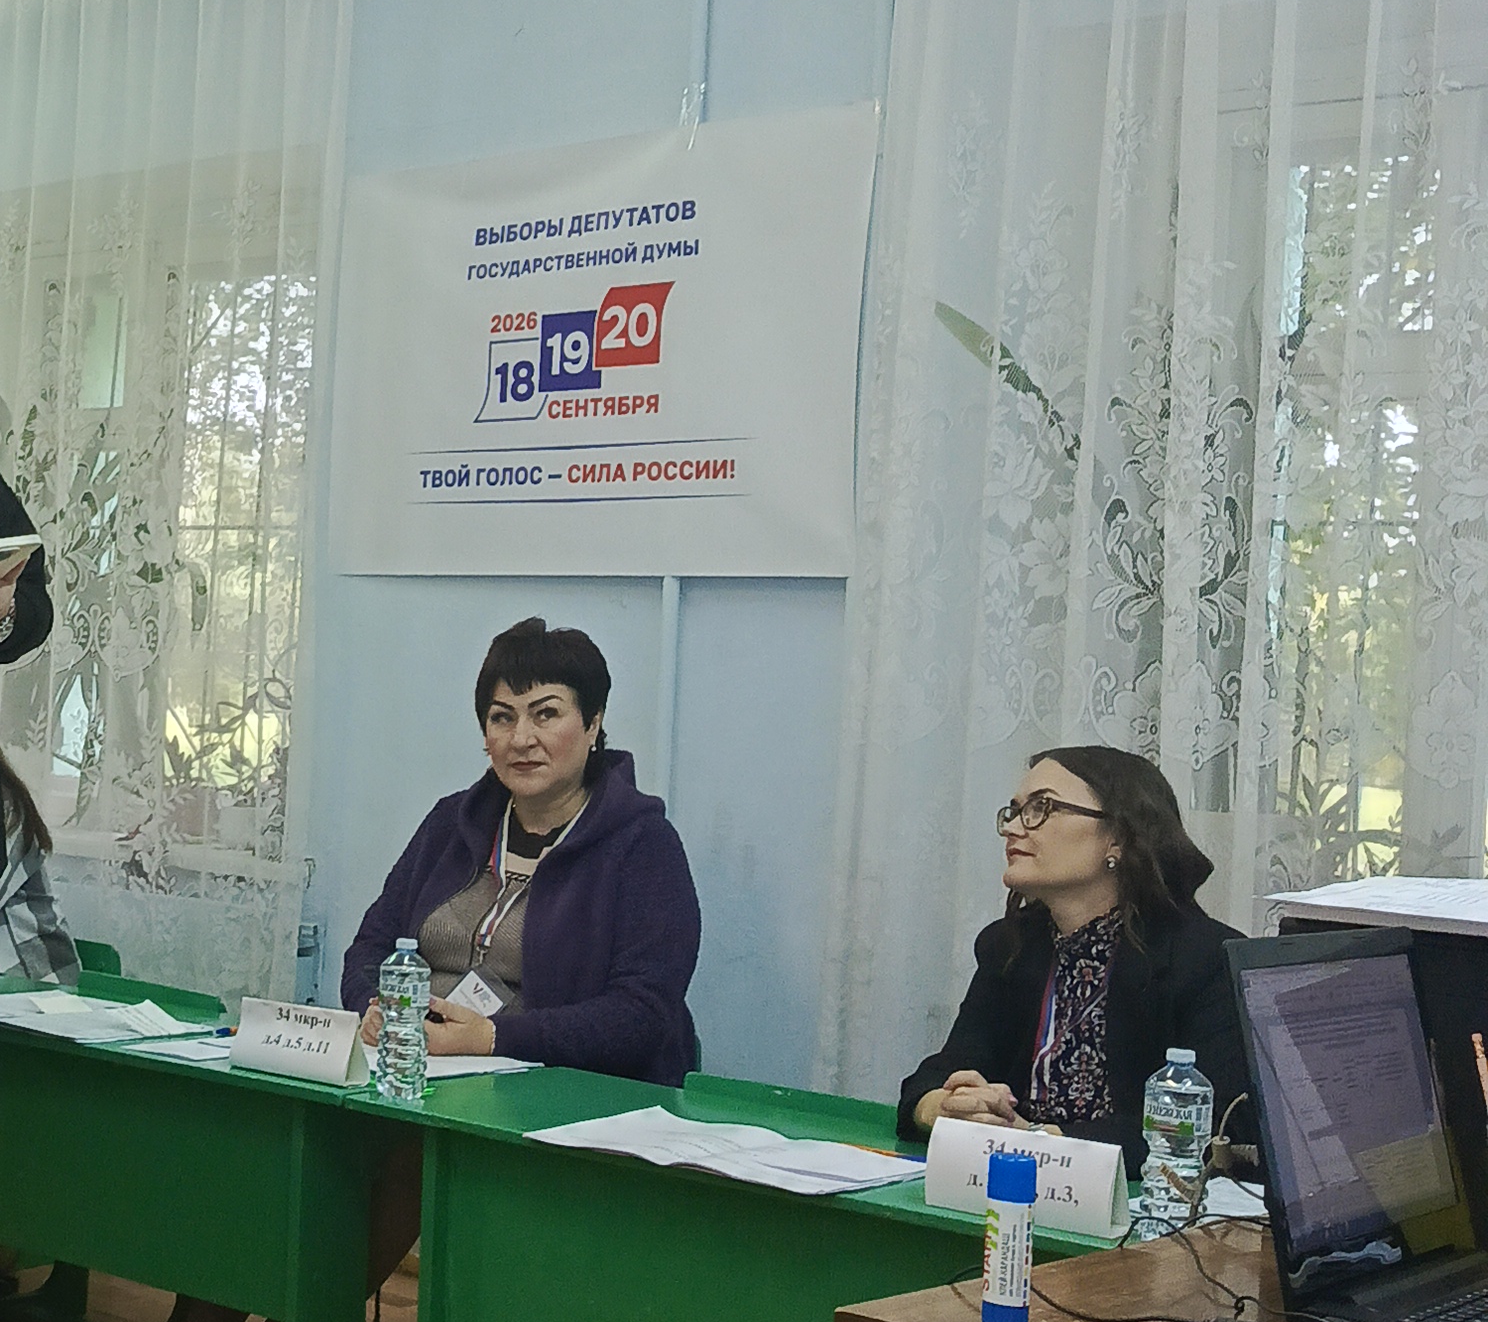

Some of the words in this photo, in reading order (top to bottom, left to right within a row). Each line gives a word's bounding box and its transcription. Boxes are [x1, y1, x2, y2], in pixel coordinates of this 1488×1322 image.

[474, 217, 565, 247] ВЫБОРЫ
[566, 199, 697, 239] ДЕПУТАТОВ
[467, 242, 638, 281] ГОСУДАРСТВЕННОЙ
[640, 238, 700, 265] ДУМЫ
[489, 310, 538, 334] 2026
[494, 359, 536, 404] 18
[546, 330, 590, 376] 19
[600, 302, 657, 350] 20
[547, 393, 660, 420] СЕНТЯБРЯ
[419, 463, 471, 489] ТВОЙ
[475, 465, 543, 487] ГОЛОС
[567, 462, 627, 484] СИЛА
[632, 458, 736, 482] РОССИИ!
[275, 1006, 292, 1023] 34
[294, 1012, 332, 1030] мкр-н
[261, 1033, 283, 1046] д.4
[282, 1037, 304, 1050] д.5
[1044, 1185, 1079, 1207] д.3,
